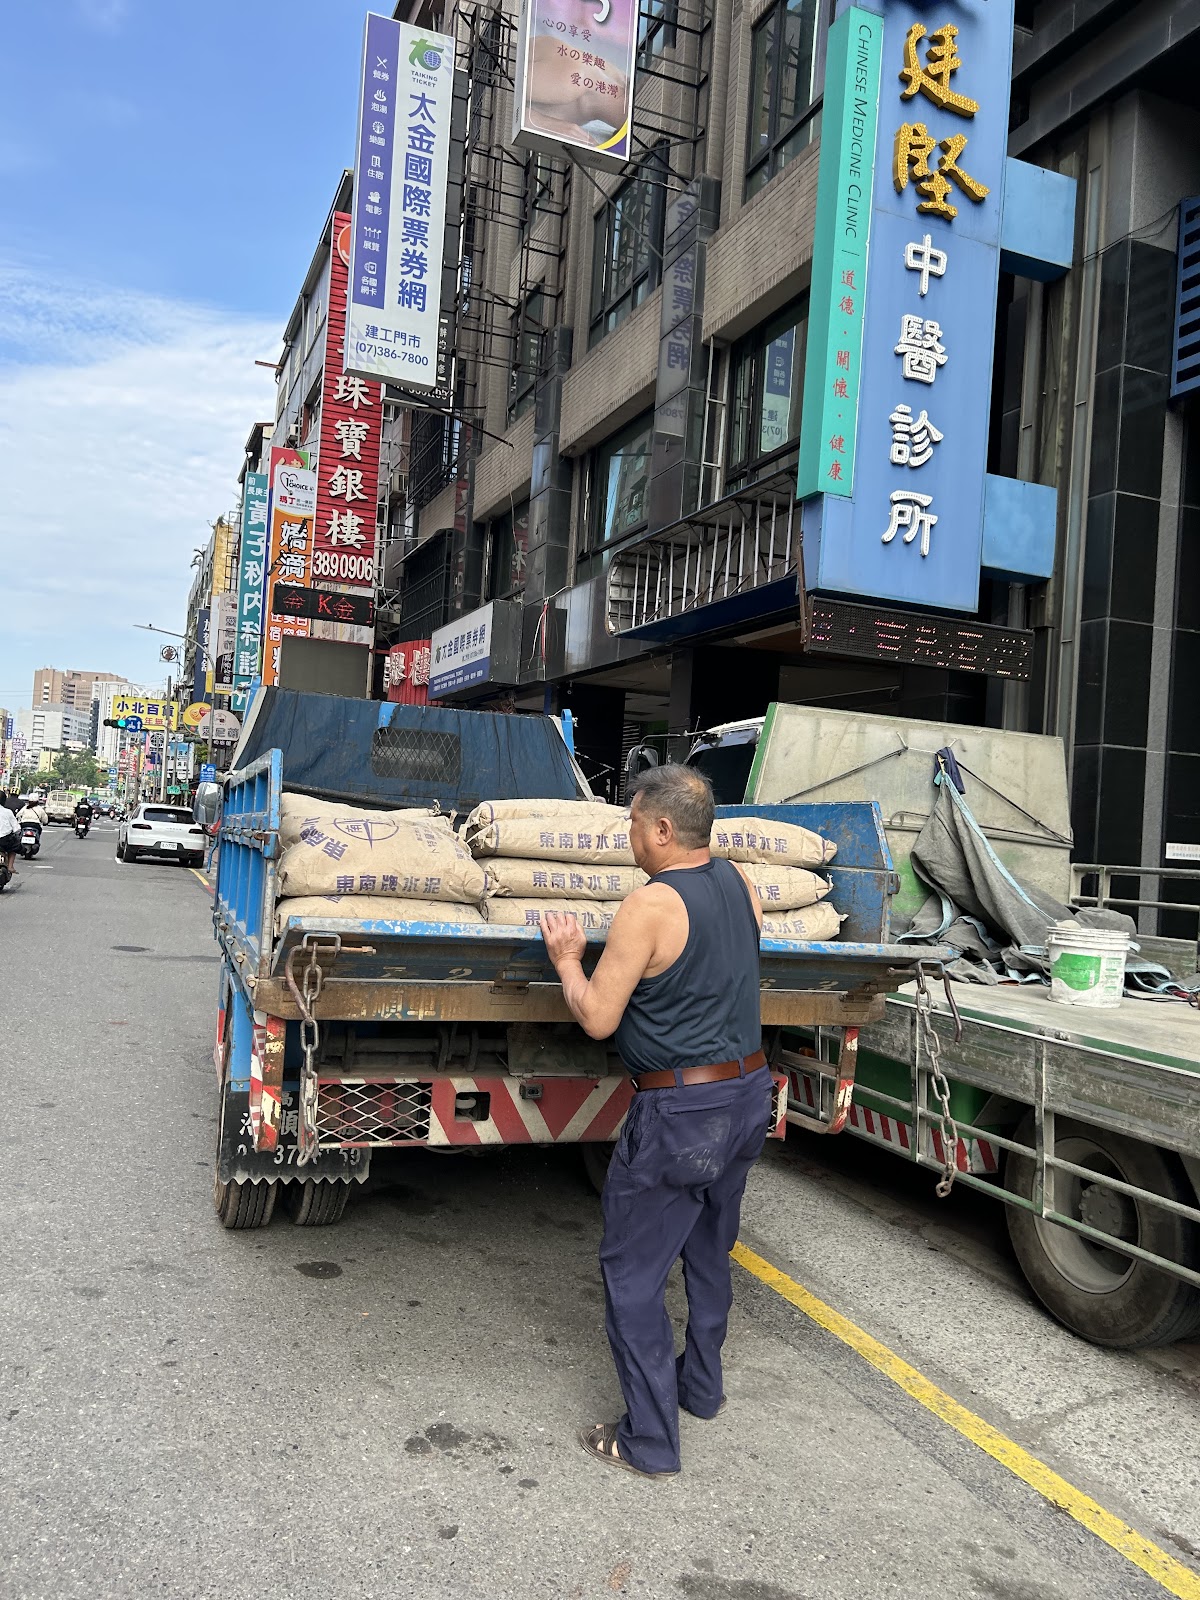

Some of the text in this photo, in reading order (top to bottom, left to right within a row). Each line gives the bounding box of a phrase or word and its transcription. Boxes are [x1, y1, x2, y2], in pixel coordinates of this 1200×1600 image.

[542, 17, 592, 42] 心の享受
[557, 44, 607, 70] 水の樂趣
[411, 70, 438, 82] TAIKING
[412, 77, 436, 88] TICKET
[570, 72, 618, 98] 愛の港灣
[845, 24, 872, 238] CHINESE MEDICINE CLINIC
[367, 169, 384, 181] 住宿
[365, 204, 383, 216] 電影
[397, 92, 437, 313] 太金國際票券網
[365, 324, 421, 349] 建工門市
[355, 341, 429, 366] (07)386-7800
[325, 376, 373, 550] 珠寶銀樓
[289, 482, 308, 491] CHOICE
[539, 831, 629, 849] 東南牌水泥
[716, 832, 788, 854] 東南牌水泥
[336, 874, 441, 895] 東南牌水泥
[532, 871, 621, 892] 東南牌水泥
